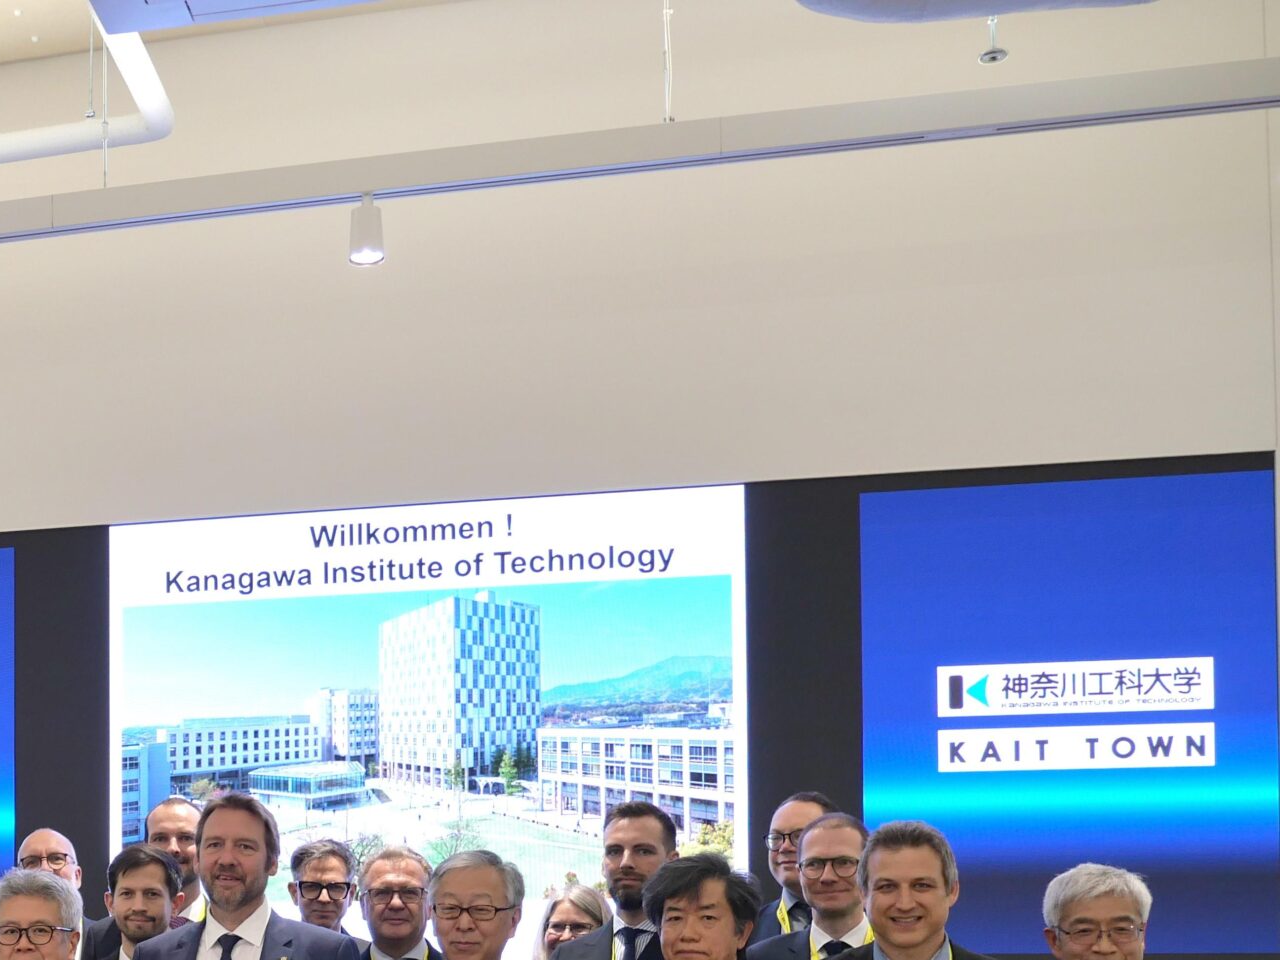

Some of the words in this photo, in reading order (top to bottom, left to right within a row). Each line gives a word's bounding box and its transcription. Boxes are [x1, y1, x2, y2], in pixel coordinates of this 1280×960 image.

[309, 519, 494, 548] Willkommen
[166, 567, 312, 595] Kanagawa
[323, 557, 443, 584] Institute
[454, 552, 484, 577] of
[493, 545, 675, 575] Technology
[1001, 666, 1202, 699] 神奈川工科大学
[948, 739, 1049, 763] KAIT
[1086, 735, 1206, 759] TOWN
